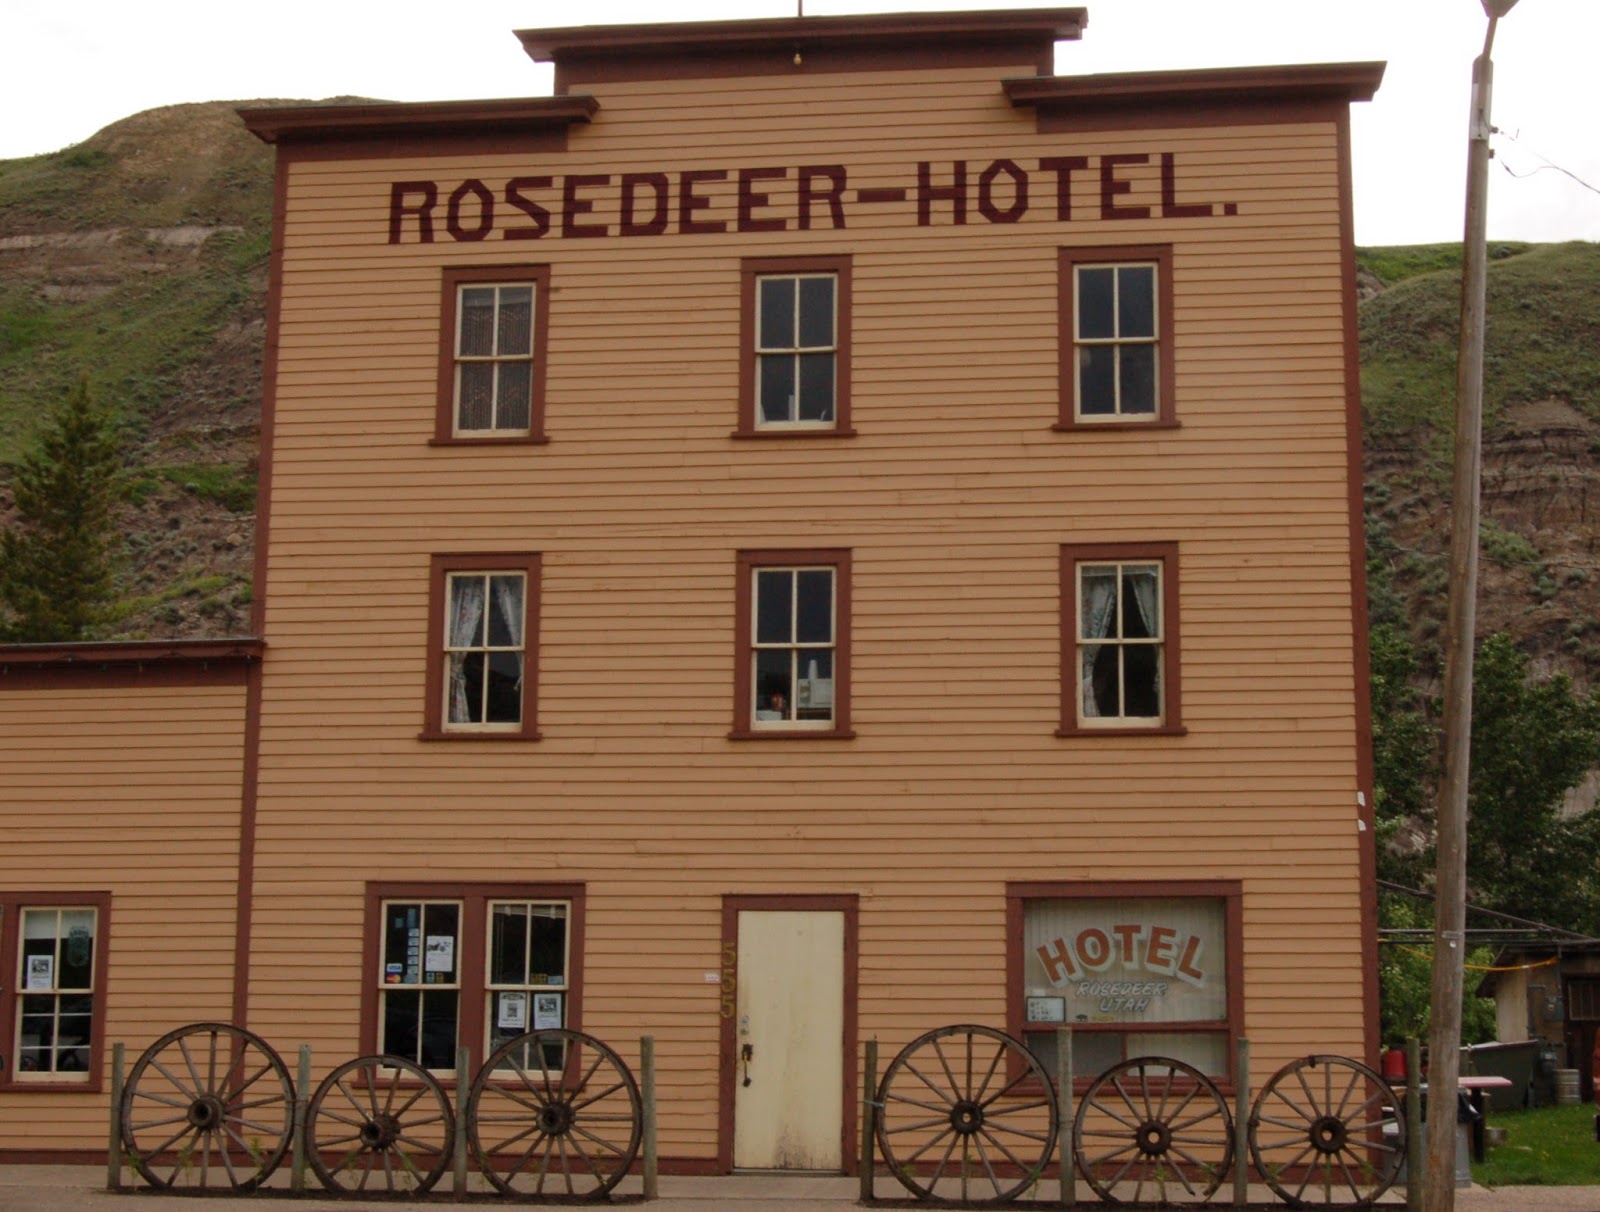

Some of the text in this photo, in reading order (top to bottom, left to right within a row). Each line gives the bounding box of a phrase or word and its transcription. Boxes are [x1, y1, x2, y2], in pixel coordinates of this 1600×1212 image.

[1036, 924, 1206, 989] HOTEL
[1076, 981, 1168, 996] ROSEDEER
[1099, 997, 1150, 1012] UTAH
